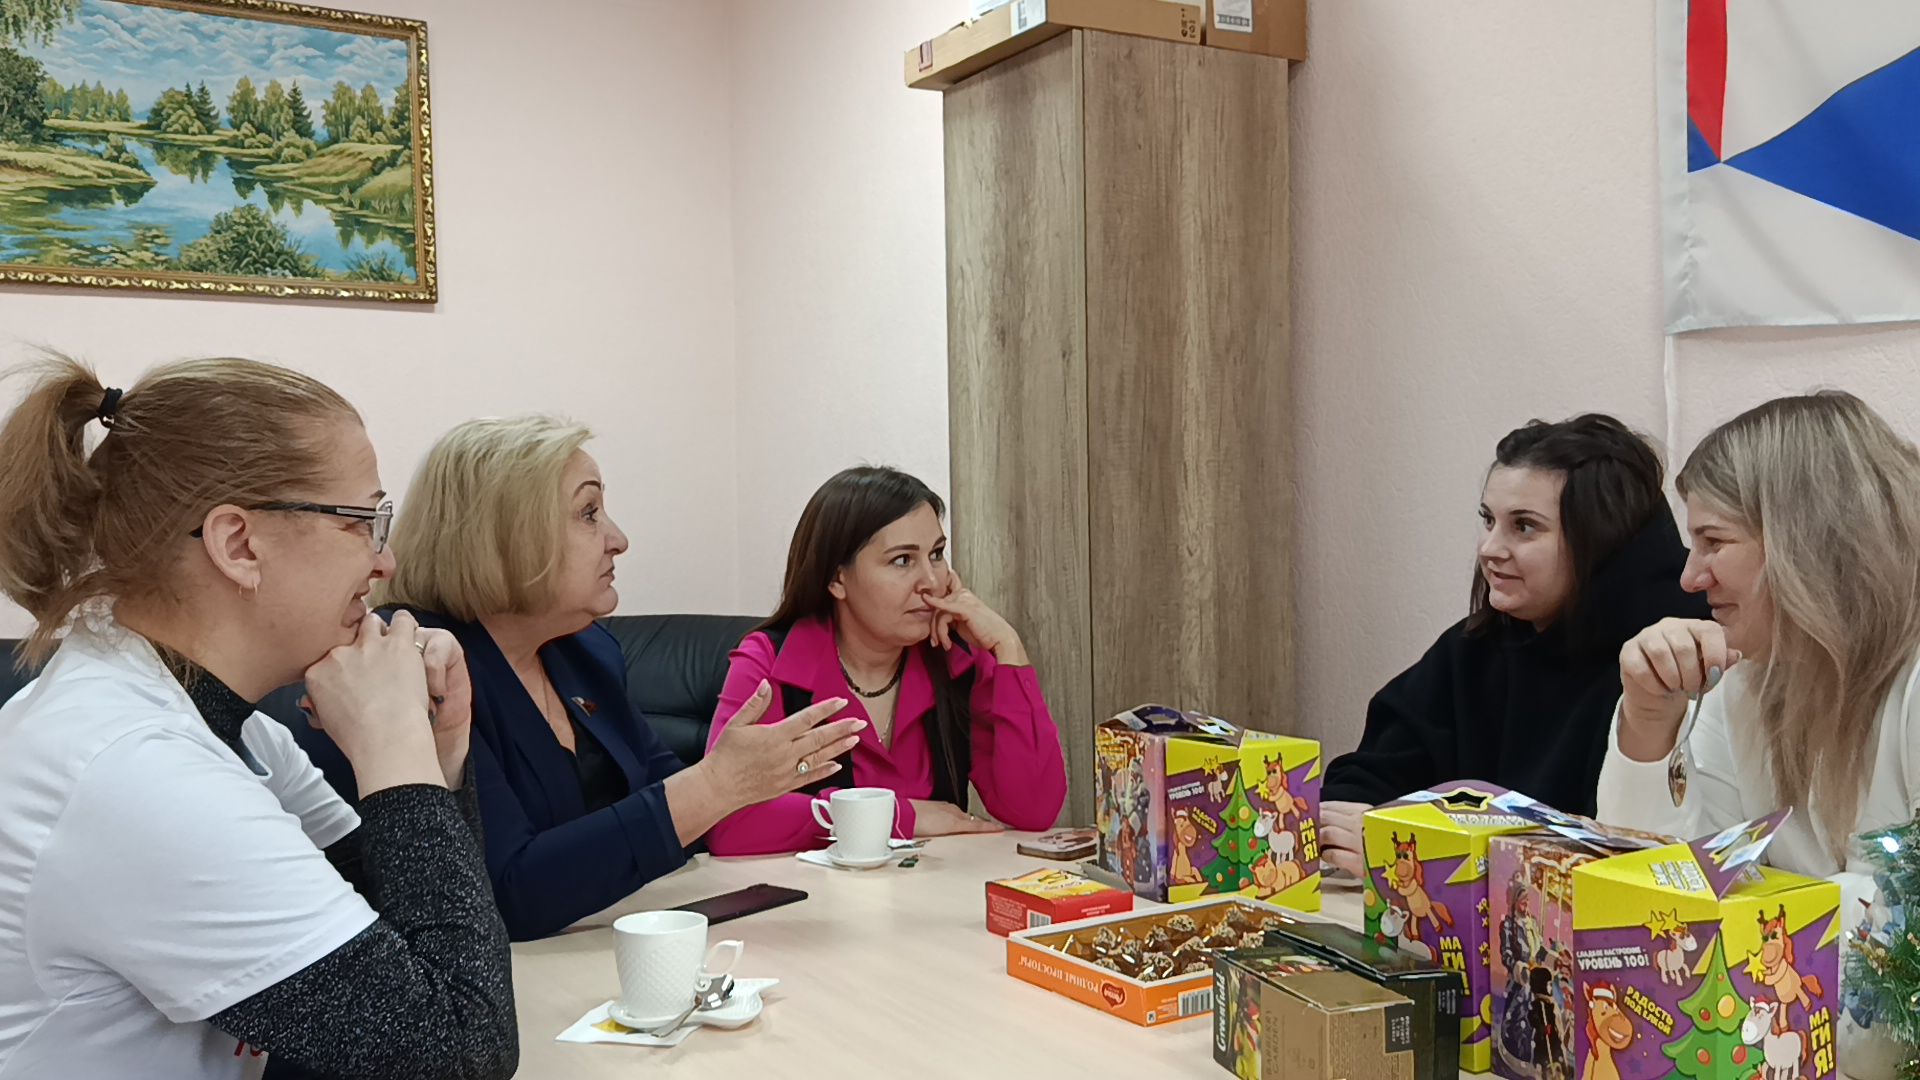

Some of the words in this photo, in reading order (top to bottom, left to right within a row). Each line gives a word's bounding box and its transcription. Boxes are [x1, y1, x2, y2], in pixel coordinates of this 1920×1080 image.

[1300, 818, 1315, 832] МА
[1302, 830, 1316, 846] ГИ
[1304, 844, 1318, 861] Я!
[1440, 936, 1462, 950] МА
[1442, 951, 1466, 971] ГИ
[1578, 956, 1623, 971] УРОВЕНЬ
[1623, 954, 1650, 968] 100!
[1215, 970, 1227, 1052] Greenfield
[1624, 995, 1642, 1016] ПОД
[1626, 986, 1674, 1026] РАДОСТЬ
[1809, 1006, 1829, 1030] МА
[1811, 1022, 1831, 1051] ГИ
[1814, 1043, 1834, 1078] Я!
